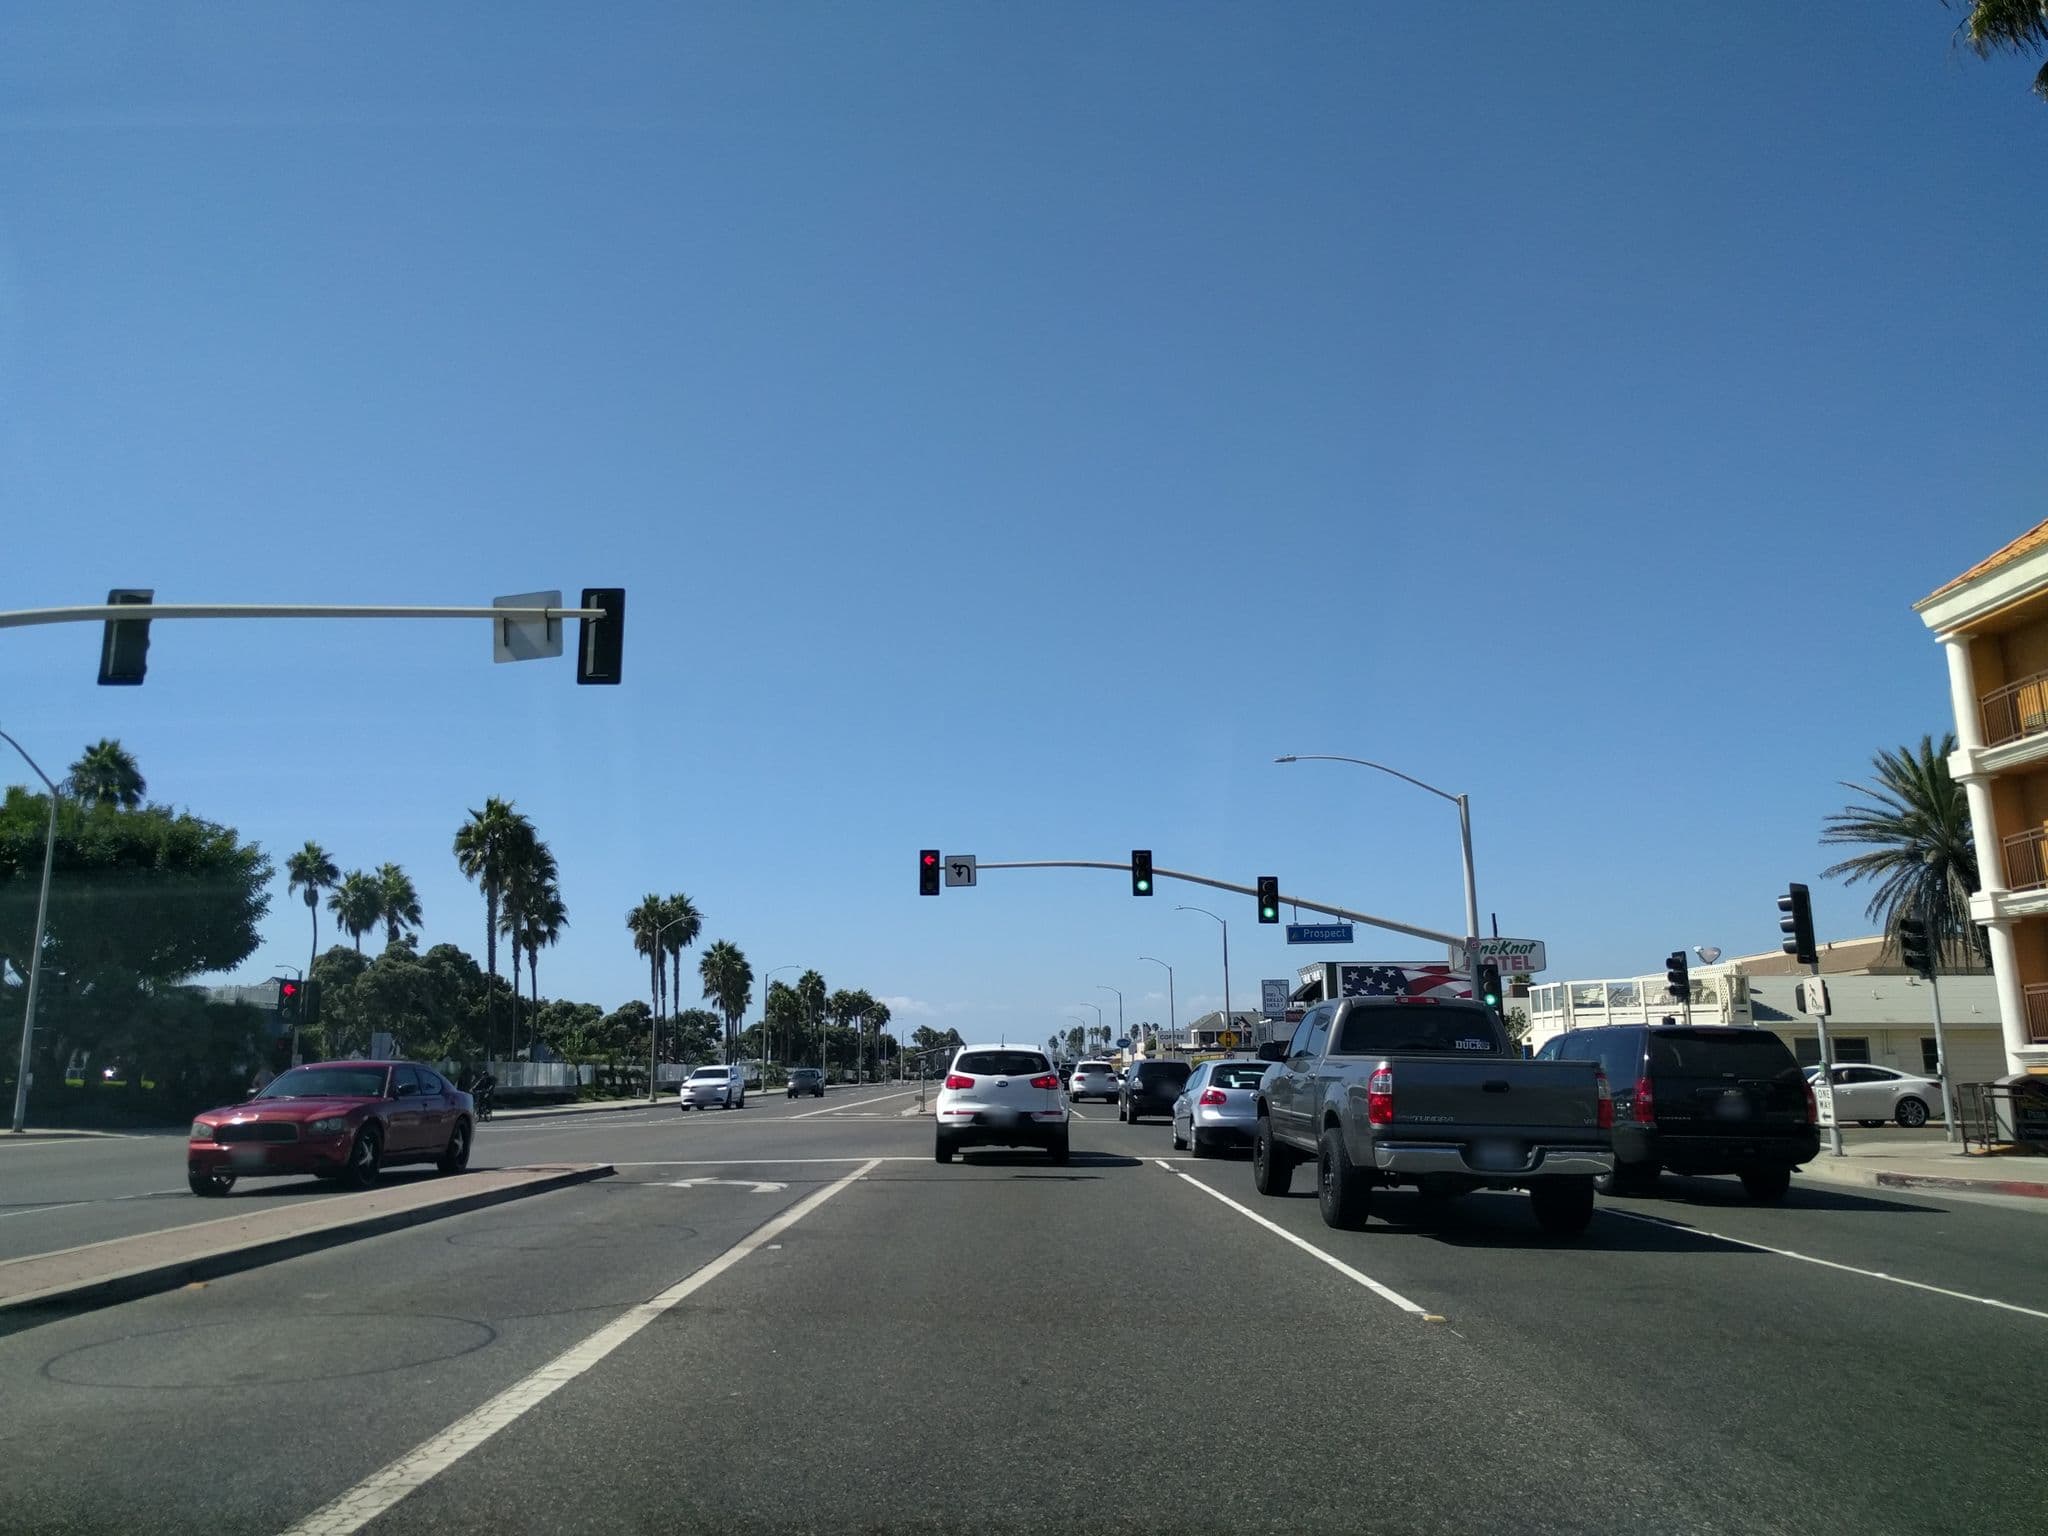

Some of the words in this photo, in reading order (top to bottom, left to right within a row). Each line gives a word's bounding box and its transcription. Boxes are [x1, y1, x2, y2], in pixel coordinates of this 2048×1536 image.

[1303, 928, 1346, 939] Prospect
[1463, 940, 1537, 955] neKnot
[1818, 1089, 1831, 1098] ONE
[1819, 1100, 1832, 1109] WAY
